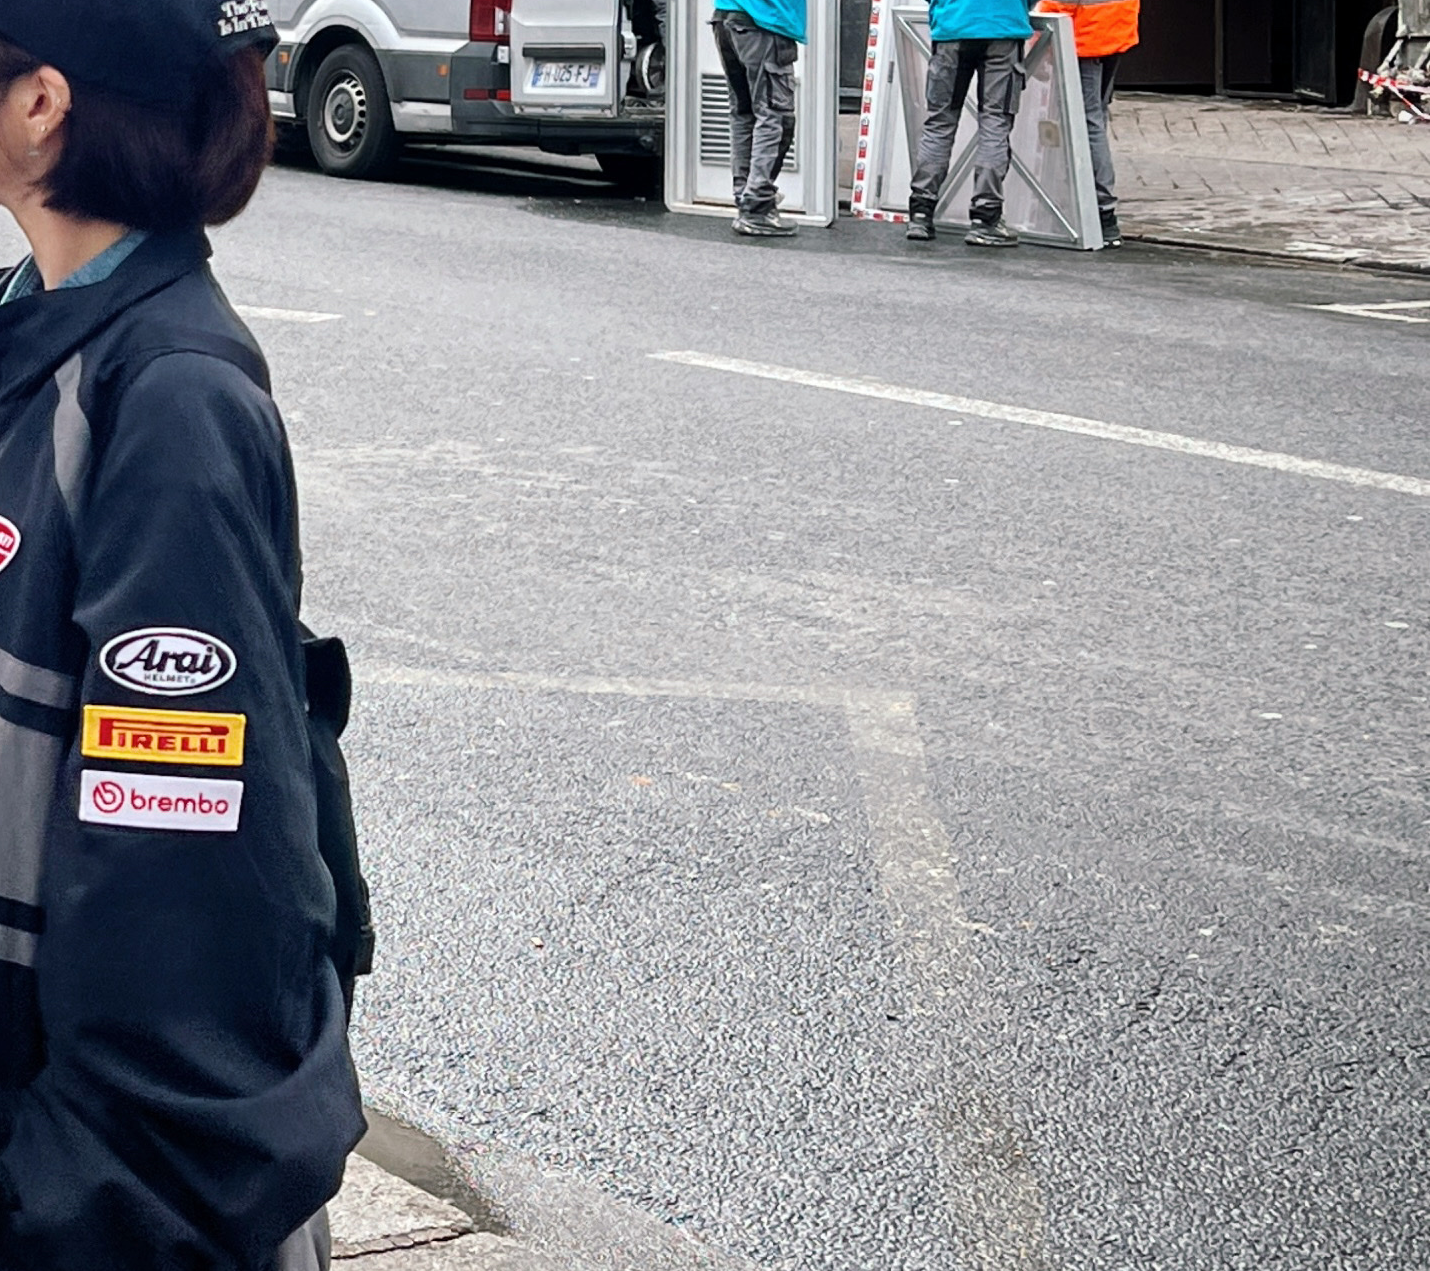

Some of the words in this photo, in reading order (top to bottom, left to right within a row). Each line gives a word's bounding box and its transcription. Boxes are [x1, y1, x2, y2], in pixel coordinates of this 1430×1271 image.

[115, 639, 218, 675] Arai
[143, 674, 190, 684] HELMET
[98, 717, 230, 754] PIRELLI
[130, 788, 229, 815] brembo
